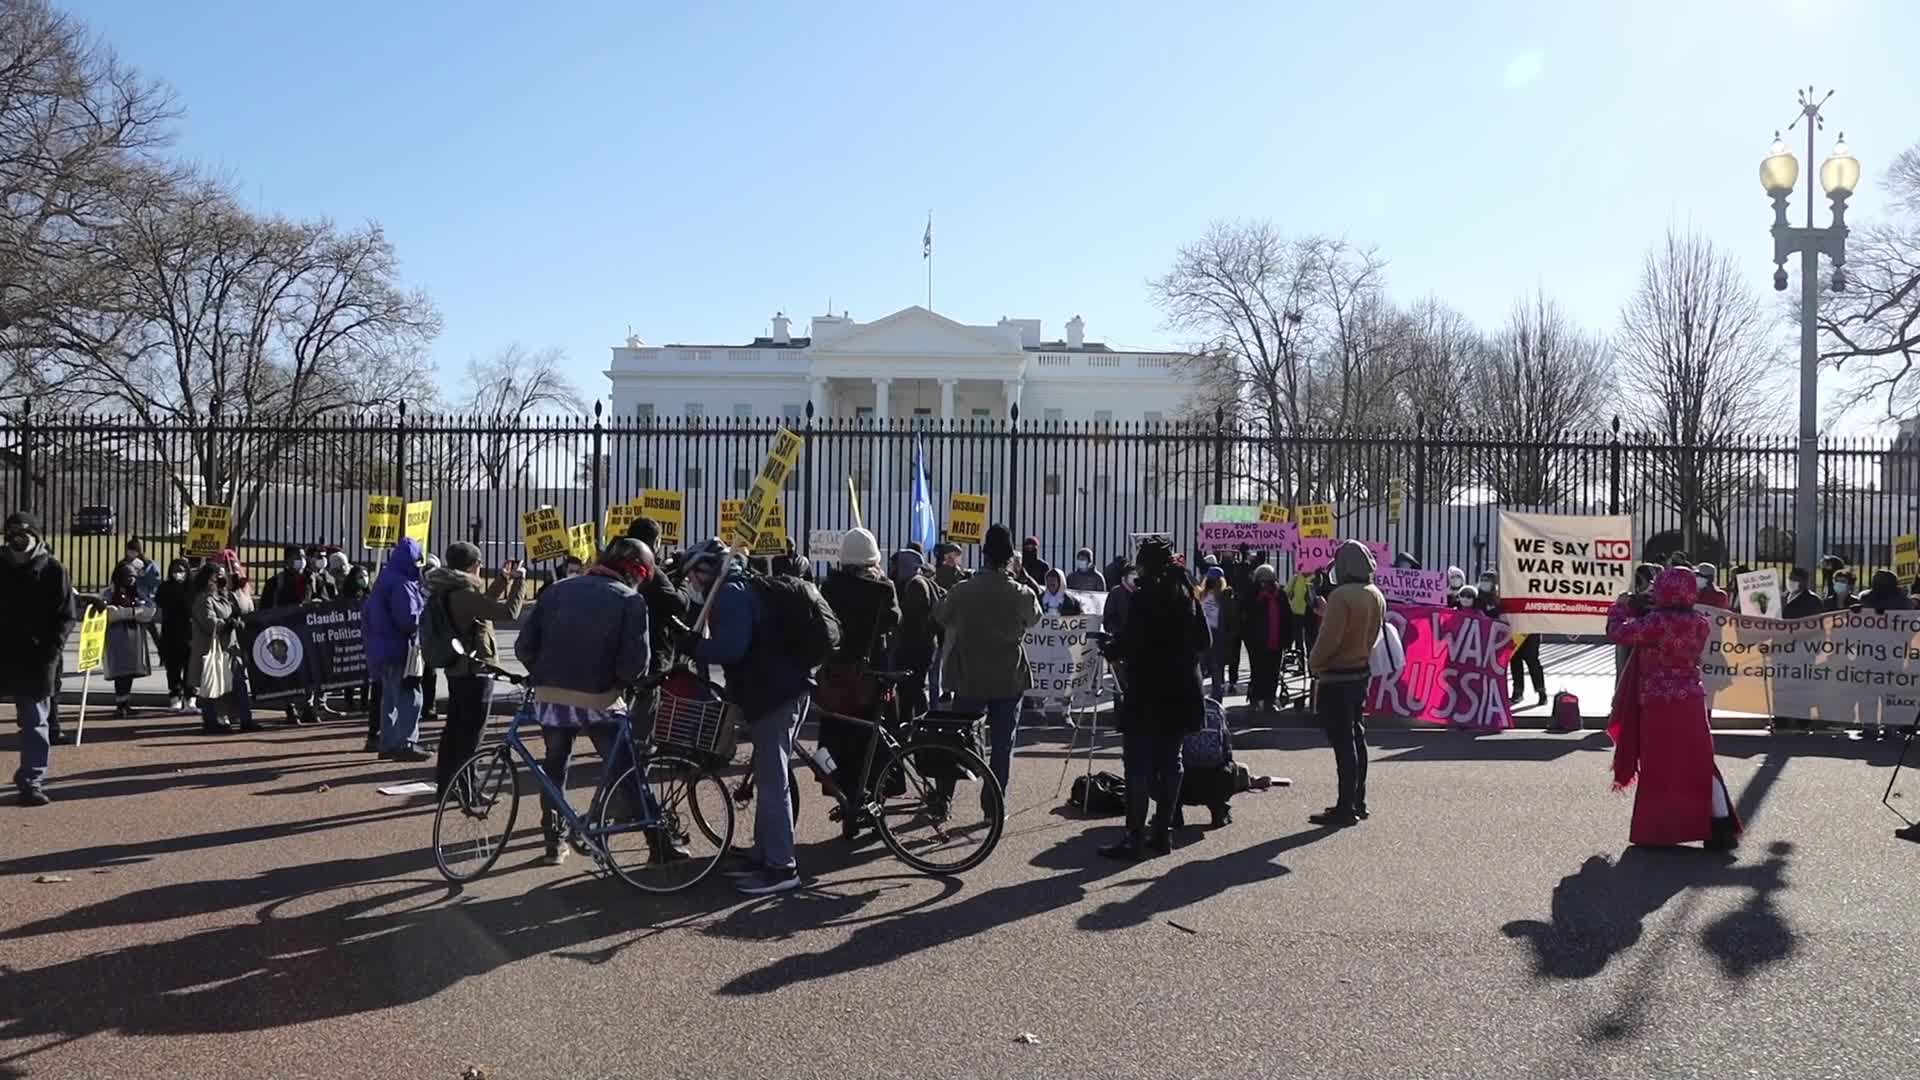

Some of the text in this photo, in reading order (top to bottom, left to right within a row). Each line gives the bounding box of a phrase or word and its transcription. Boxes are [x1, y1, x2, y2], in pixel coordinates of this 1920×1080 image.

[645, 497, 680, 511] DISBAND
[952, 500, 985, 512] DISBAND
[523, 509, 555, 524] WE SAY
[368, 526, 395, 539] NATO!
[527, 520, 559, 537] NO WAR
[952, 520, 980, 536] NATO!
[1205, 527, 1286, 540] REPARATIONS
[532, 539, 564, 555] RUSSIA
[1514, 538, 1629, 559] WE SAY NO
[1518, 558, 1624, 577] WAR WITH
[1529, 578, 1613, 596] RUSSIA!
[306, 611, 344, 625] Claudia
[1041, 619, 1088, 630] PEACE
[1832, 612, 1888, 629] blood
[312, 632, 326, 643] for
[1024, 633, 1088, 647] GIVE YOU
[1432, 612, 1508, 675] WAR
[1710, 640, 1755, 654] poor
[1758, 640, 1796, 653] and
[1803, 638, 1887, 661] working
[1743, 663, 1831, 680] capitalist
[1836, 665, 1920, 687] dictator
[1376, 662, 1509, 728] RUSSIA
